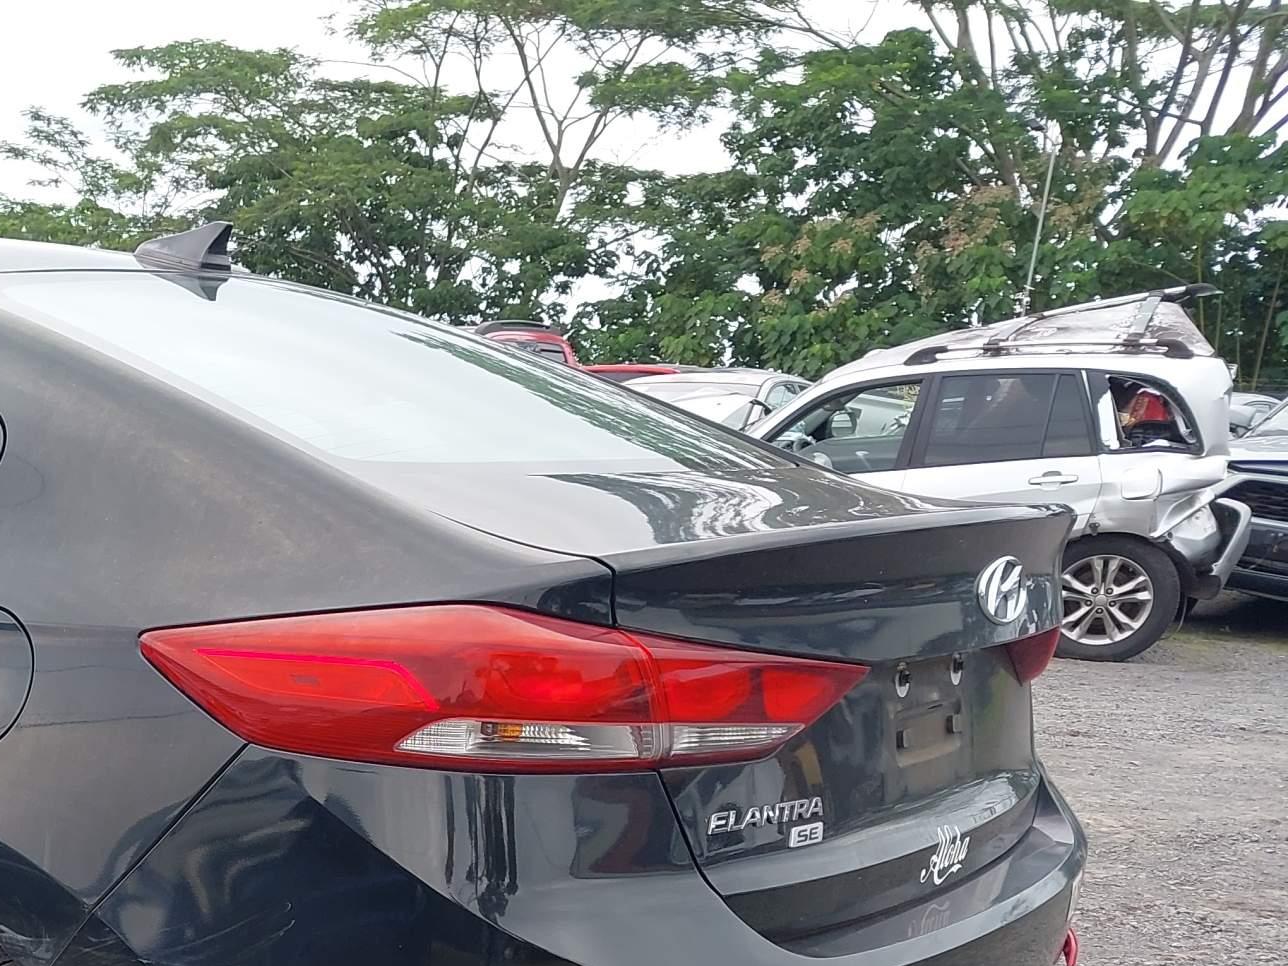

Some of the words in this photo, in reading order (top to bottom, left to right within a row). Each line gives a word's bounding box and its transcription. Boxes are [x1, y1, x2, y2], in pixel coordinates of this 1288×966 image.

[707, 797, 824, 835] ELANTRA
[795, 825, 821, 844] SE
[920, 824, 970, 885] Aloha
